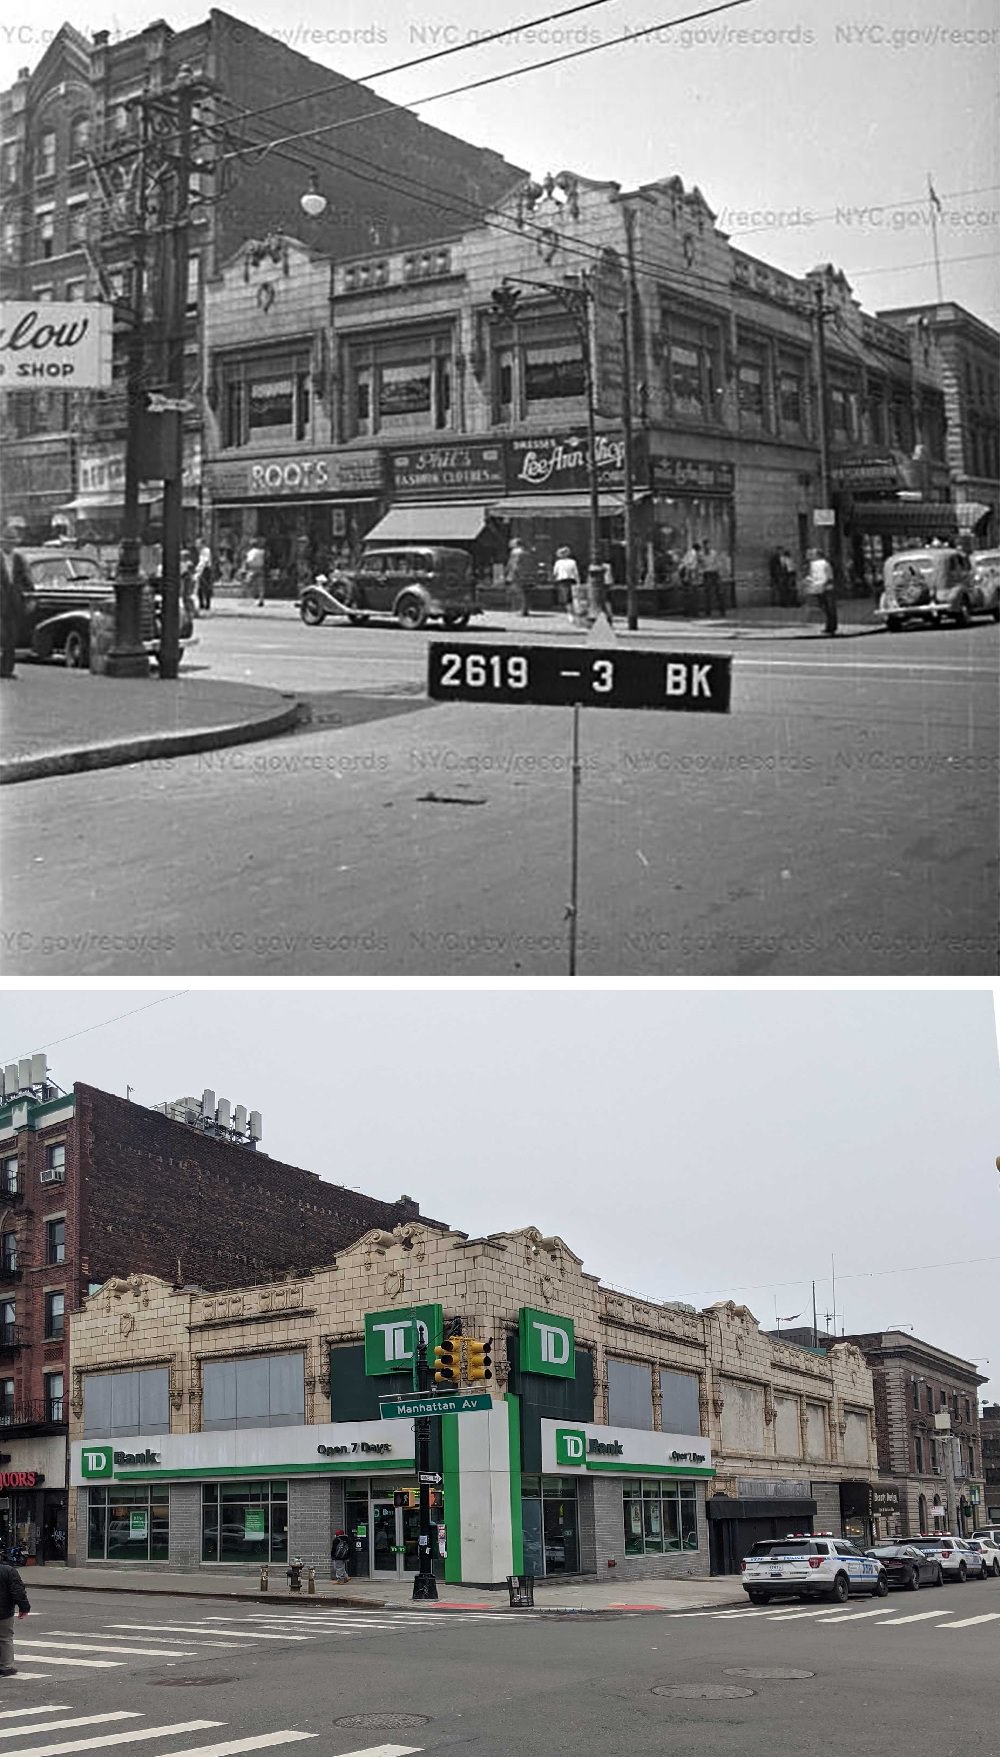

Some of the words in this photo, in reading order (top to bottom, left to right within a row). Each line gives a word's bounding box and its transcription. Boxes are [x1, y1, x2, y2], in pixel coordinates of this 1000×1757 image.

[0, 311, 89, 351] low
[16, 363, 75, 376] SHOP
[517, 451, 553, 484] Lee
[549, 446, 584, 471] Ann
[440, 653, 528, 689] 2619
[665, 663, 712, 697] BK
[532, 1321, 570, 1365] TD
[397, 1402, 456, 1415] Manhattan
[462, 1399, 478, 1409] Av
[317, 1444, 348, 1456] Open
[350, 1442, 360, 1453] 7
[361, 1441, 391, 1455] Days
[563, 1435, 584, 1458] TD
[588, 1439, 624, 1456] Bank
[83, 1452, 107, 1471] TD
[113, 1448, 161, 1465] Bank
